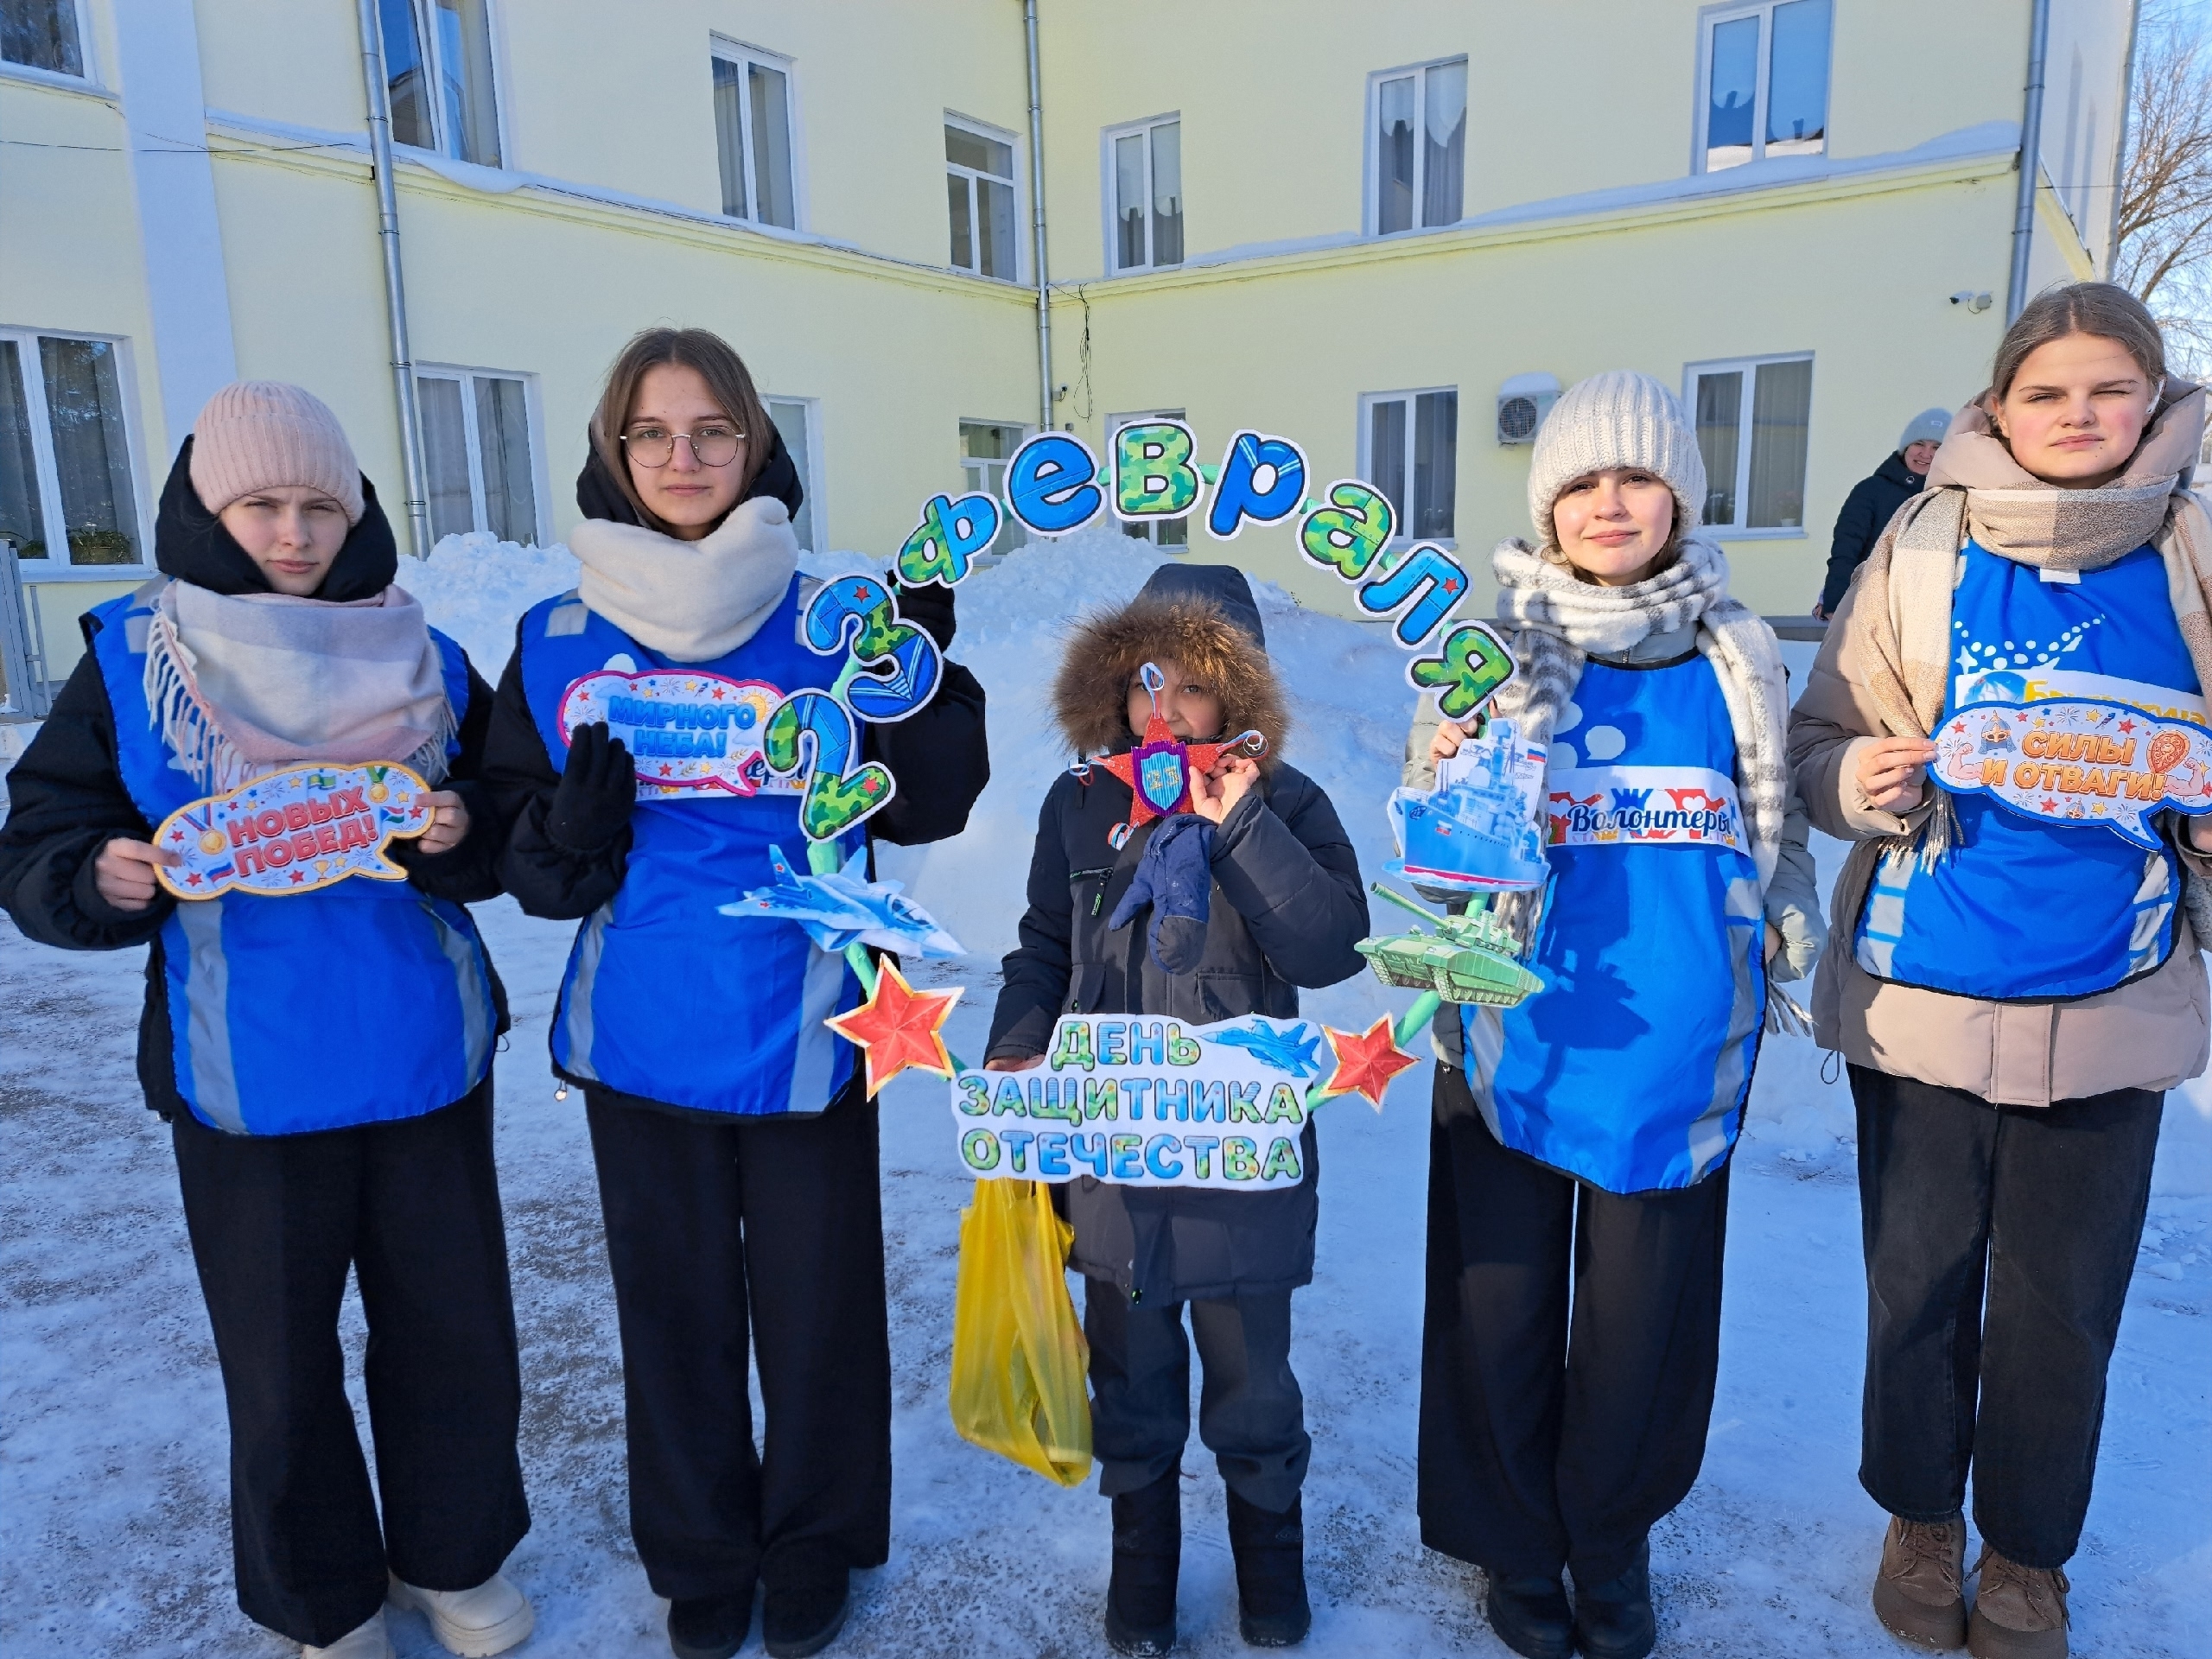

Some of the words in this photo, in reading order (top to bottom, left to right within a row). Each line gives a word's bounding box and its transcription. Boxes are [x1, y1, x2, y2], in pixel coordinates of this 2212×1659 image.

[607, 695, 757, 730] МИРНОГО
[764, 575, 940, 840] 23
[632, 729, 728, 759] НЕБА!
[2021, 729, 2138, 766] СИЛЫ
[1146, 766, 1180, 791] 23
[1980, 757, 2009, 788] И
[2012, 761, 2166, 802] ОТВАГИ!
[226, 785, 371, 848] НОВЫХ
[1567, 804, 1732, 836] Волонтеры
[232, 814, 378, 878] ПОБЕД!
[1051, 1020, 1202, 1071] ДЕНЬ
[957, 1076, 1304, 1128] ЗАЩИТНИКА
[961, 1128, 1302, 1182] ОТЕЧЕСТВА
